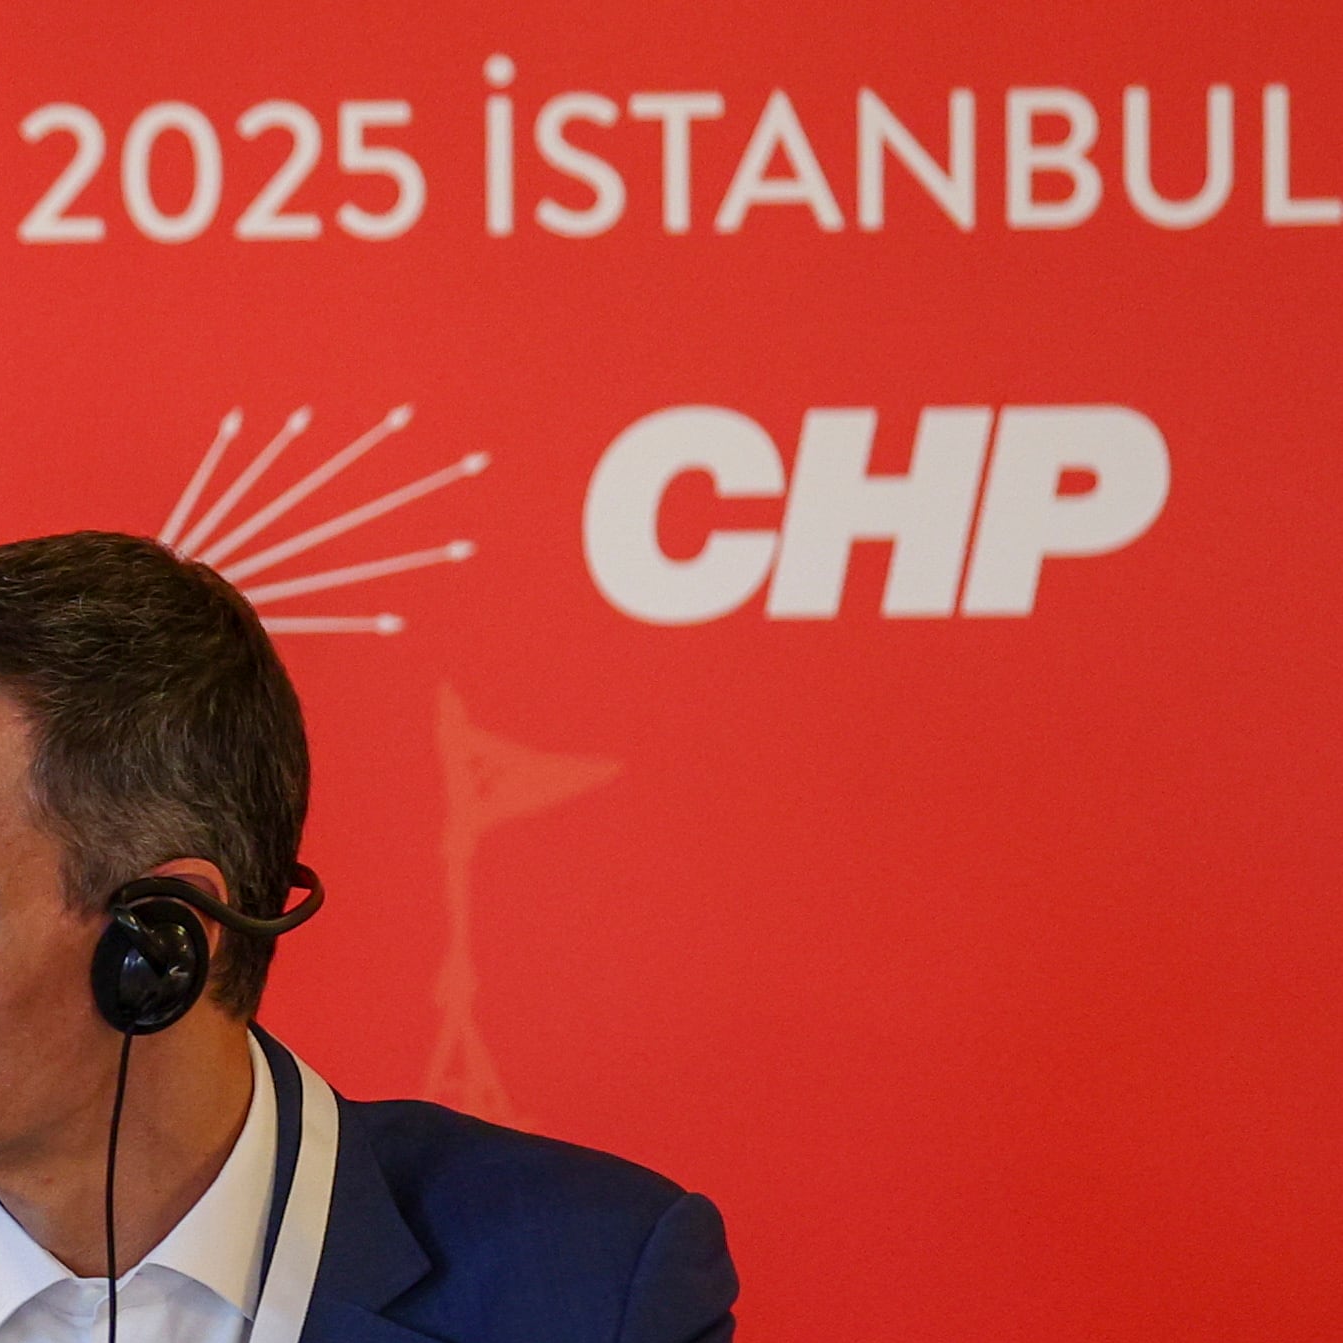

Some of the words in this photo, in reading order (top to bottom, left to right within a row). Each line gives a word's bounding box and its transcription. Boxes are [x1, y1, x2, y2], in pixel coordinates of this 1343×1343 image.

[18, 101, 426, 243] 2025
[485, 56, 1343, 236] İSTANBUL
[583, 404, 1171, 624] CHP
